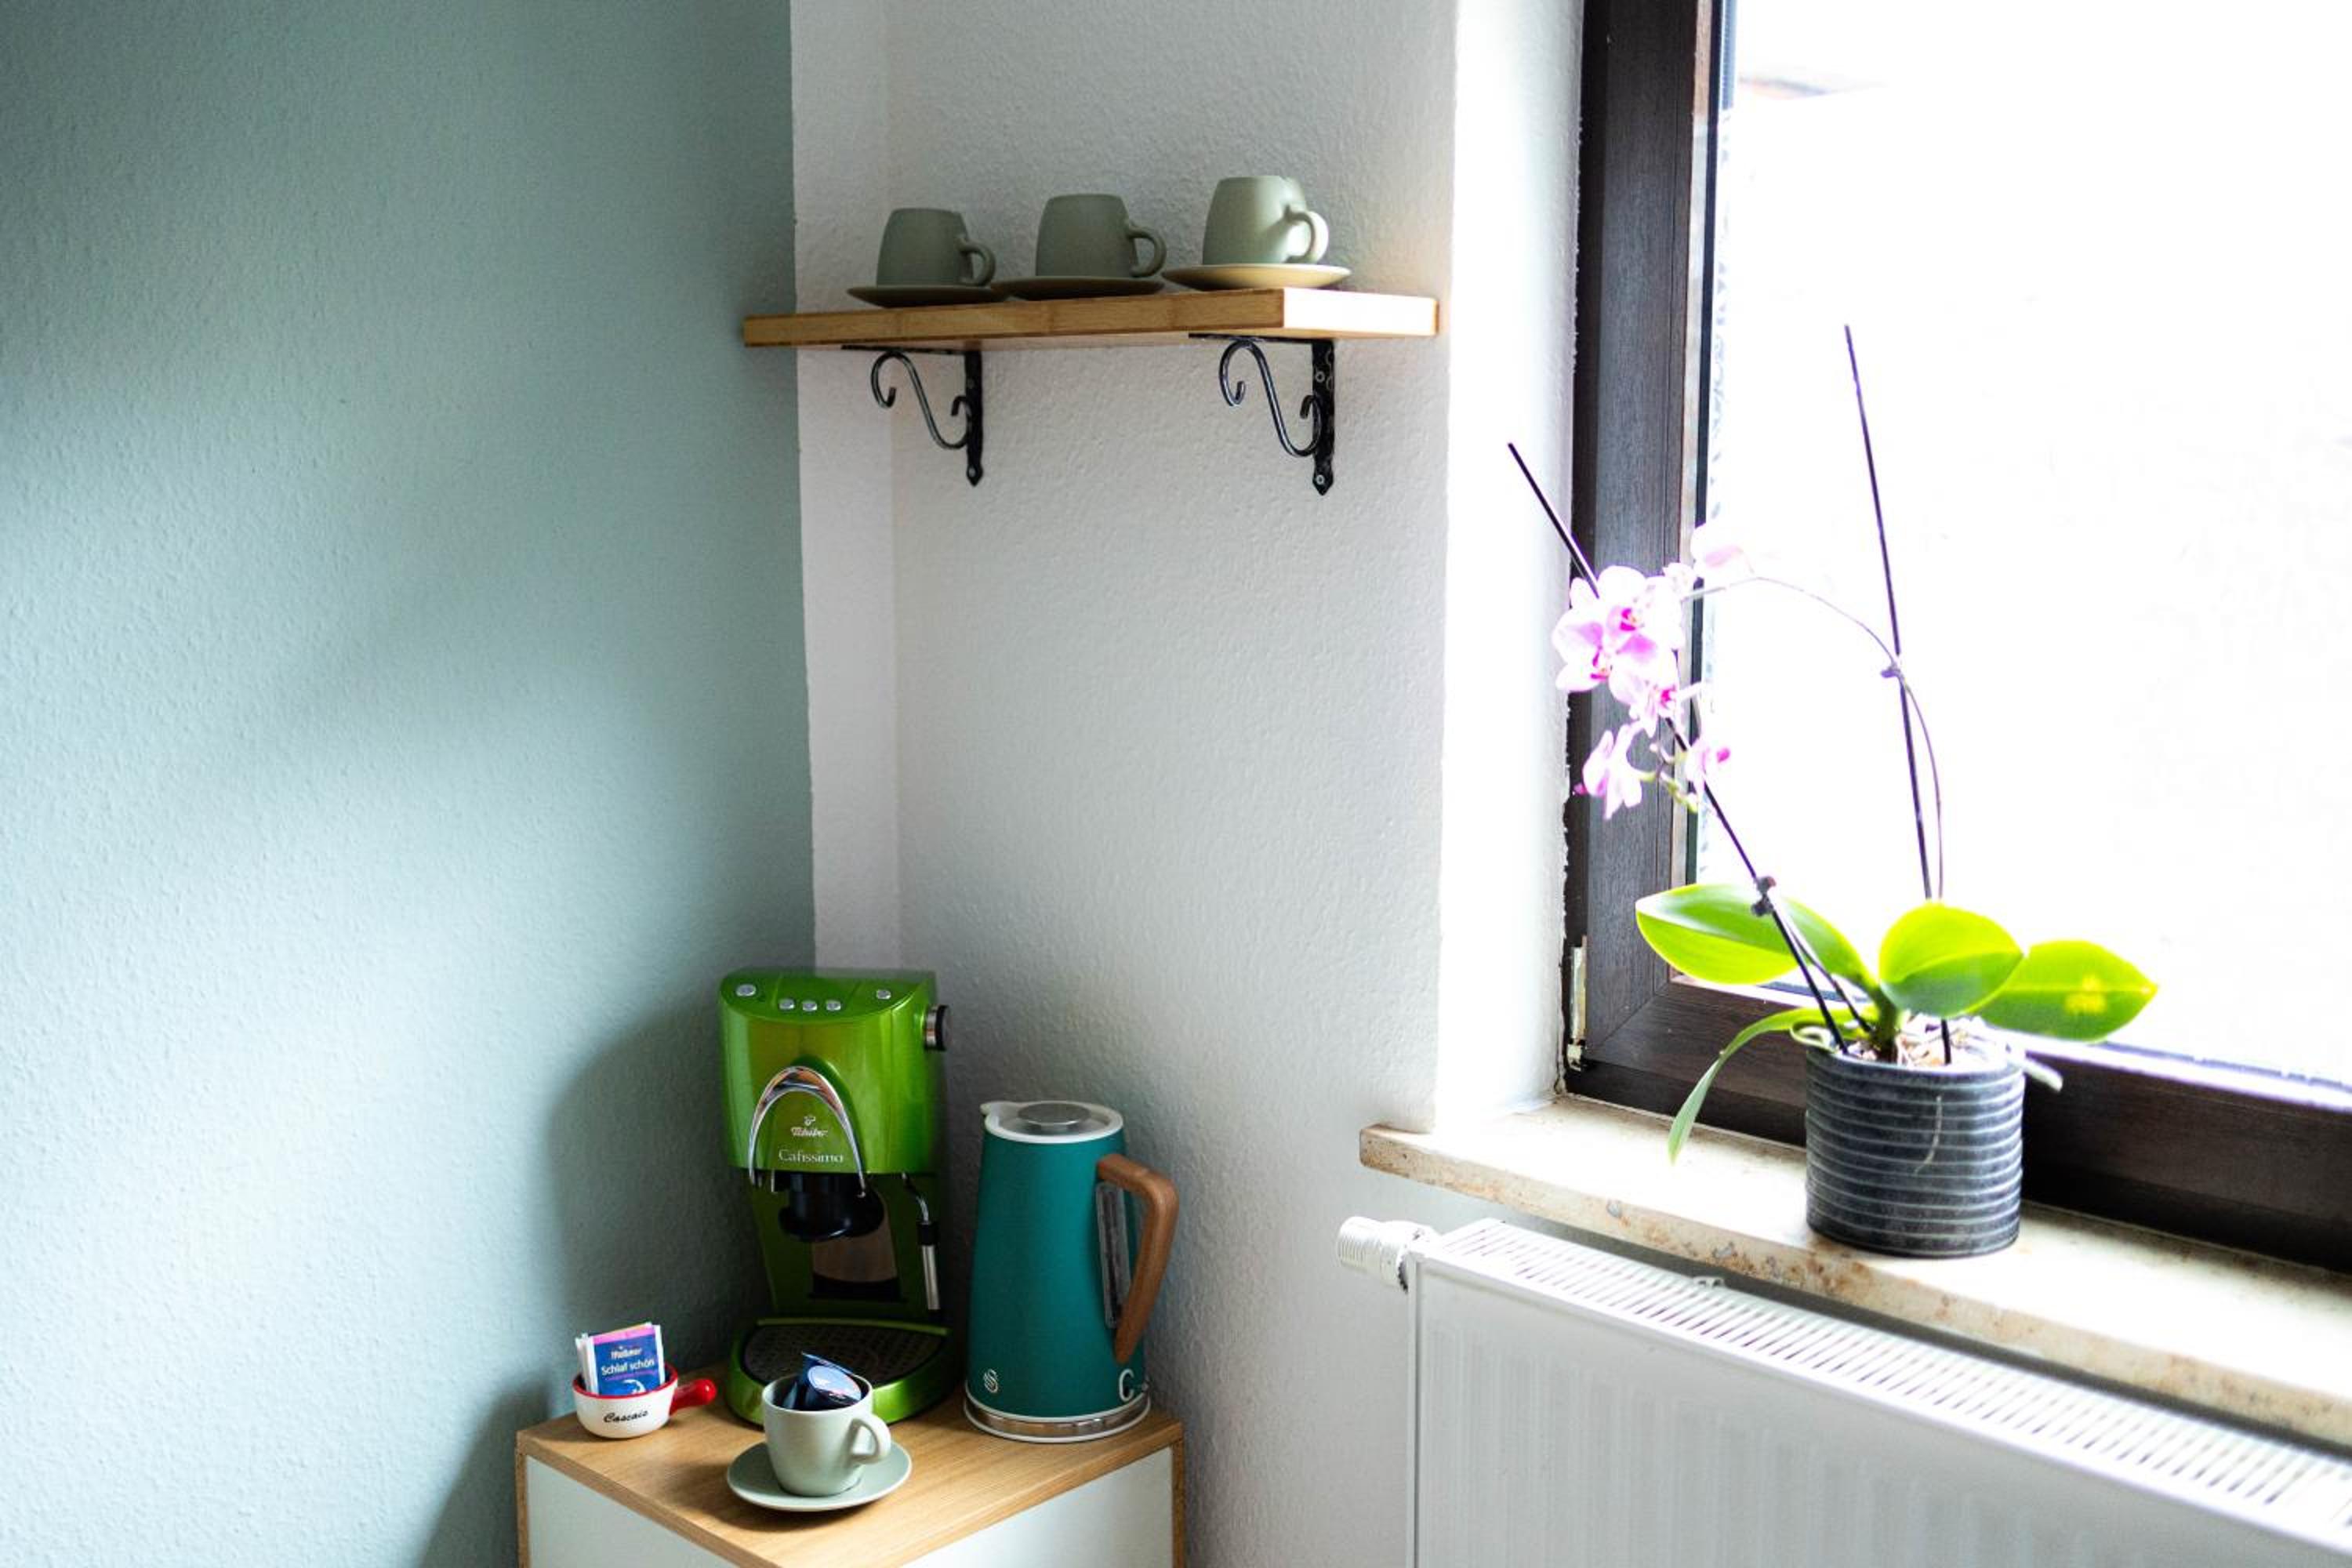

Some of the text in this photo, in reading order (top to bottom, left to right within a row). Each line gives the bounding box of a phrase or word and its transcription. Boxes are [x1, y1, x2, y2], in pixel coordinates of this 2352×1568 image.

[779, 1149, 844, 1163] Cafissimo
[601, 1362, 628, 1377] Schlaf
[630, 1358, 655, 1370] schön
